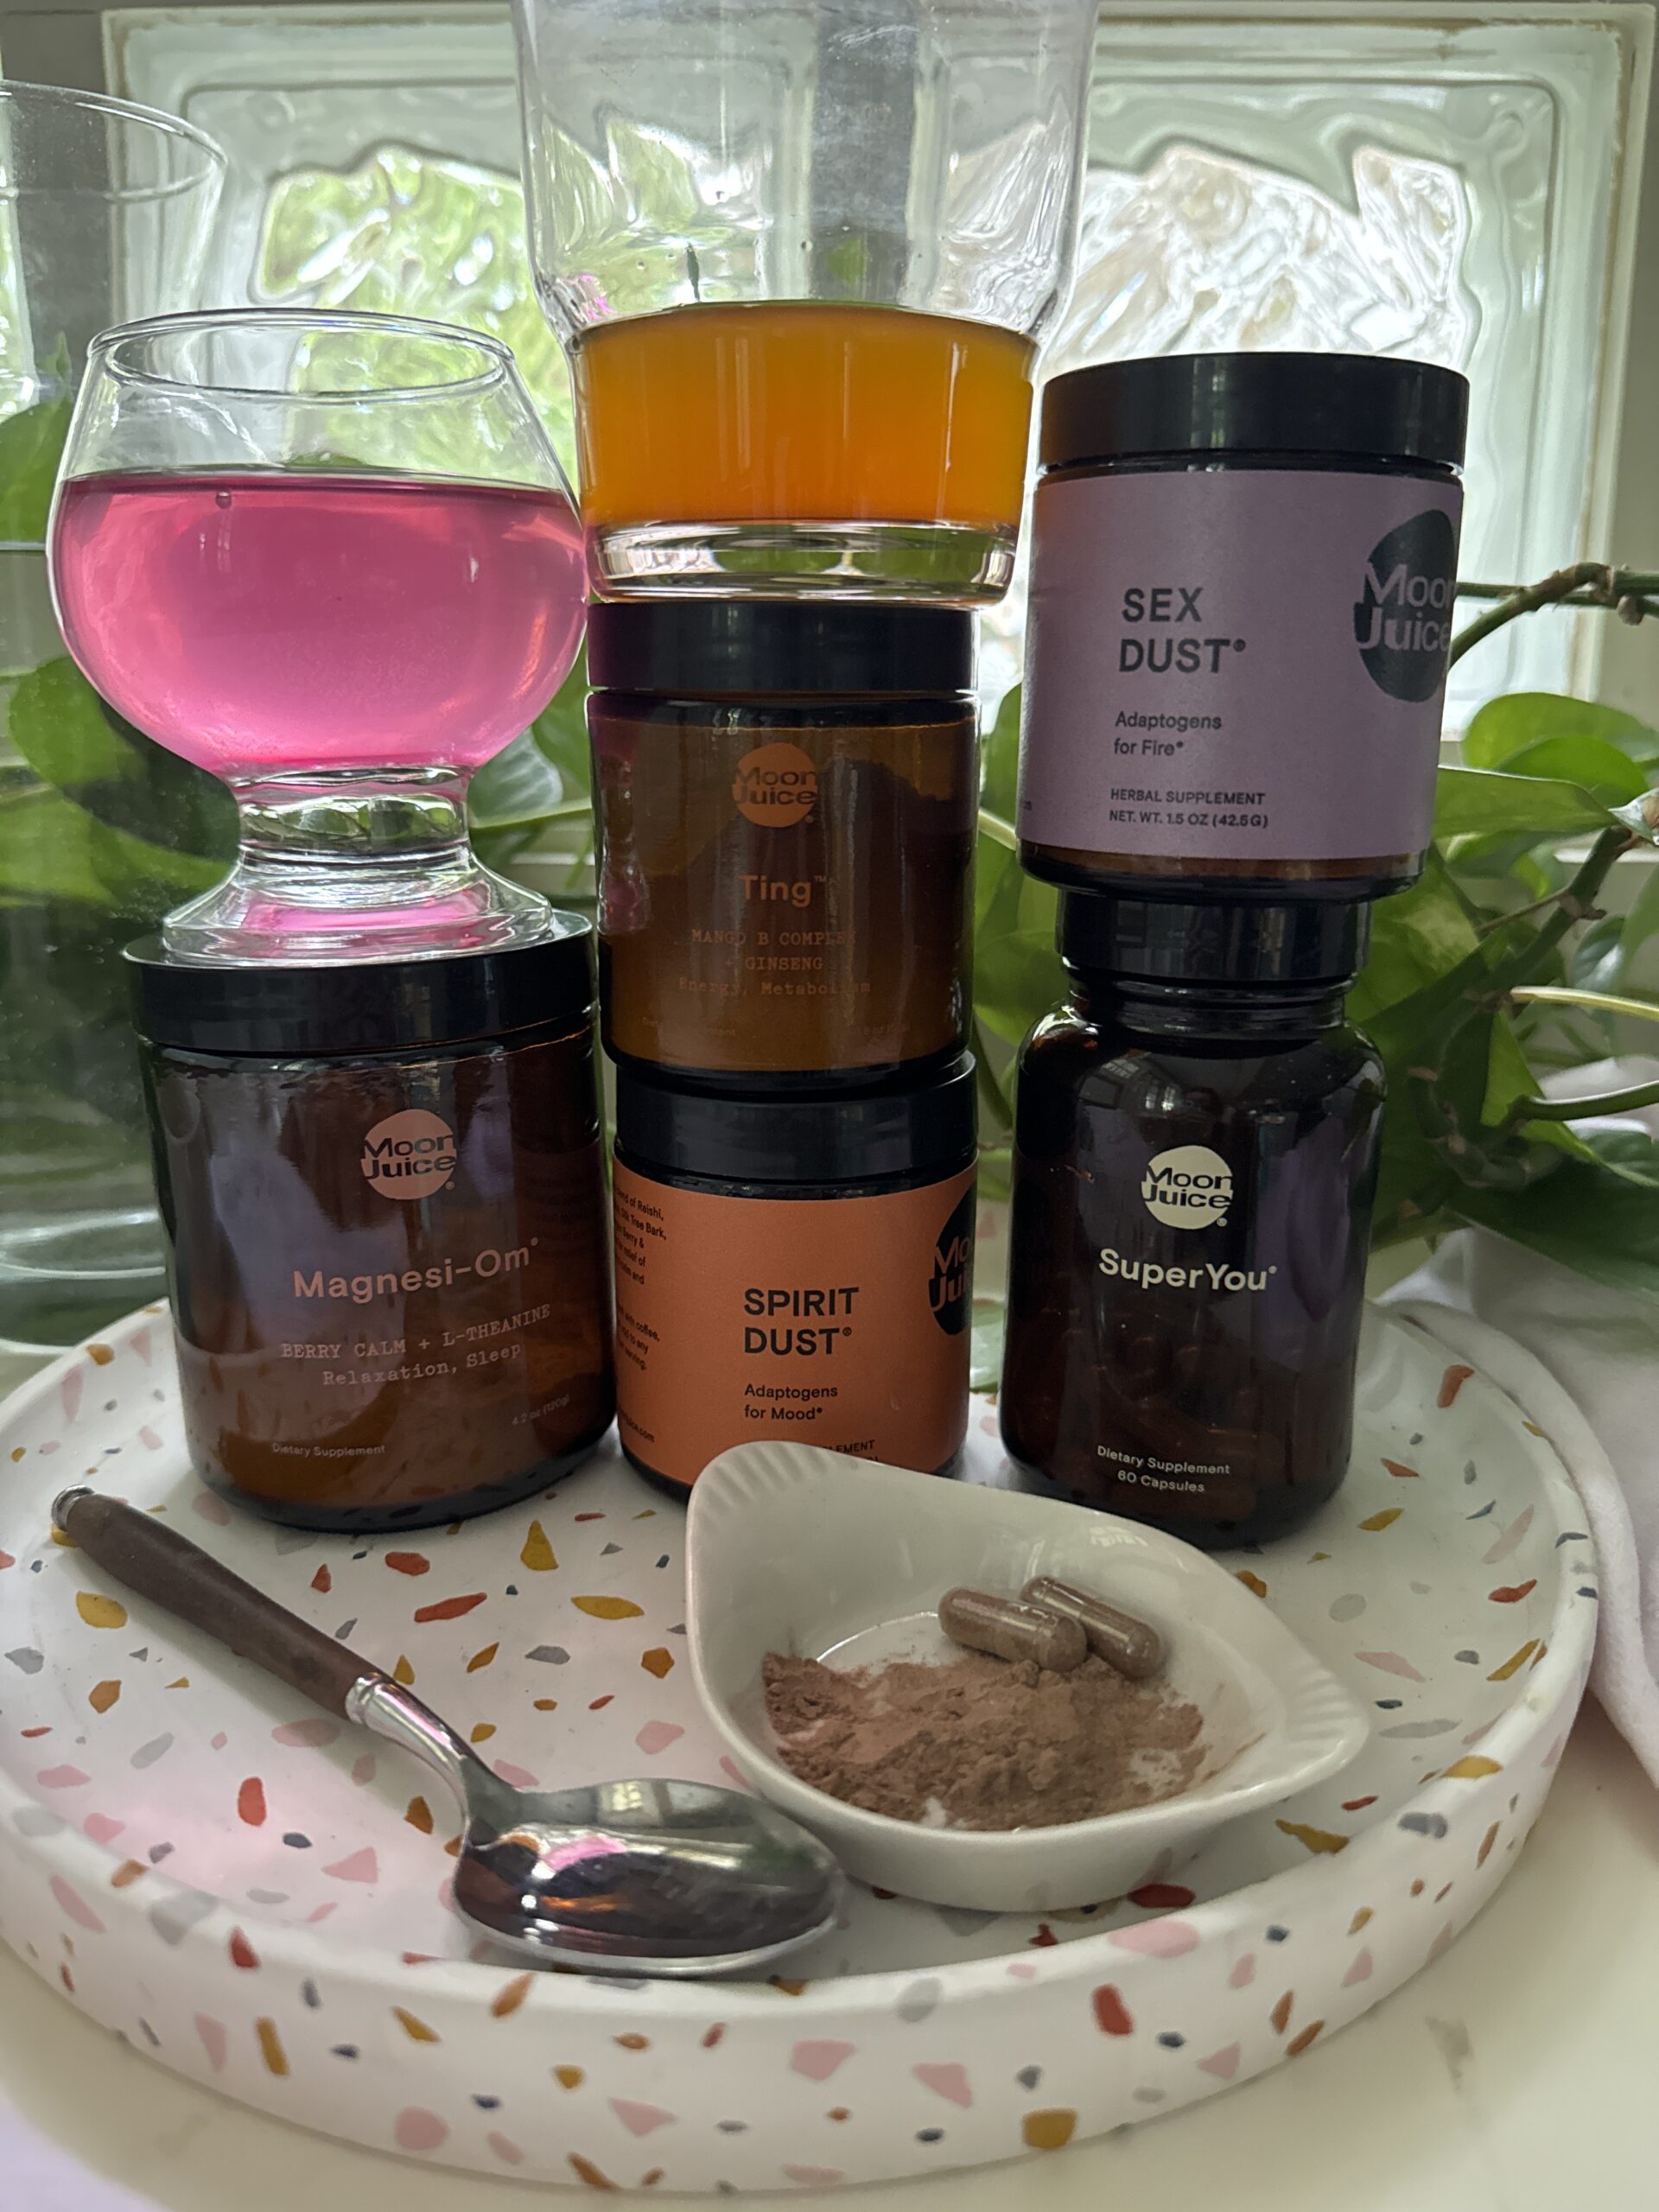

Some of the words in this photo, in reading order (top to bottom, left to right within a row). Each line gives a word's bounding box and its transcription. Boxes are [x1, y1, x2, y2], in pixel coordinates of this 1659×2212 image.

[1121, 586, 1204, 624] SEX
[1114, 709, 1223, 733] Adaptogens
[1114, 737, 1137, 755] for
[734, 766, 817, 785] Moon
[733, 785, 817, 805] Juice
[1109, 787, 1162, 803] HERBAL
[1165, 790, 1266, 805] SUPPLEMENT
[1109, 809, 1137, 823] NET.
[1140, 810, 1164, 824] WT.
[1187, 812, 1210, 826] OZ
[690, 929, 747, 945] MANGO
[757, 931, 770, 946] B
[745, 957, 824, 971] GINSENG
[364, 1134, 456, 1159] Moon
[361, 1156, 456, 1179] Juice
[1147, 1164, 1234, 1191] Moon
[1141, 1184, 1234, 1209] Juice
[743, 1285, 861, 1318] SPIRIT
[280, 1342, 342, 1359] BERRY
[353, 1338, 407, 1358] CALM
[418, 1338, 431, 1351] +
[442, 1302, 551, 1349] L-THEANINE
[322, 1360, 459, 1387] Relaxation,
[465, 1343, 522, 1370] Sleep
[744, 1382, 839, 1402] Adaptogens
[743, 1403, 766, 1420] for
[271, 1441, 311, 1459] Dietary
[313, 1444, 387, 1459] Supplement
[1096, 1444, 1145, 1469] Dietary
[1147, 1456, 1232, 1476] Supplement
[1116, 1468, 1138, 1485] 60
[1140, 1473, 1207, 1493] Capsules
